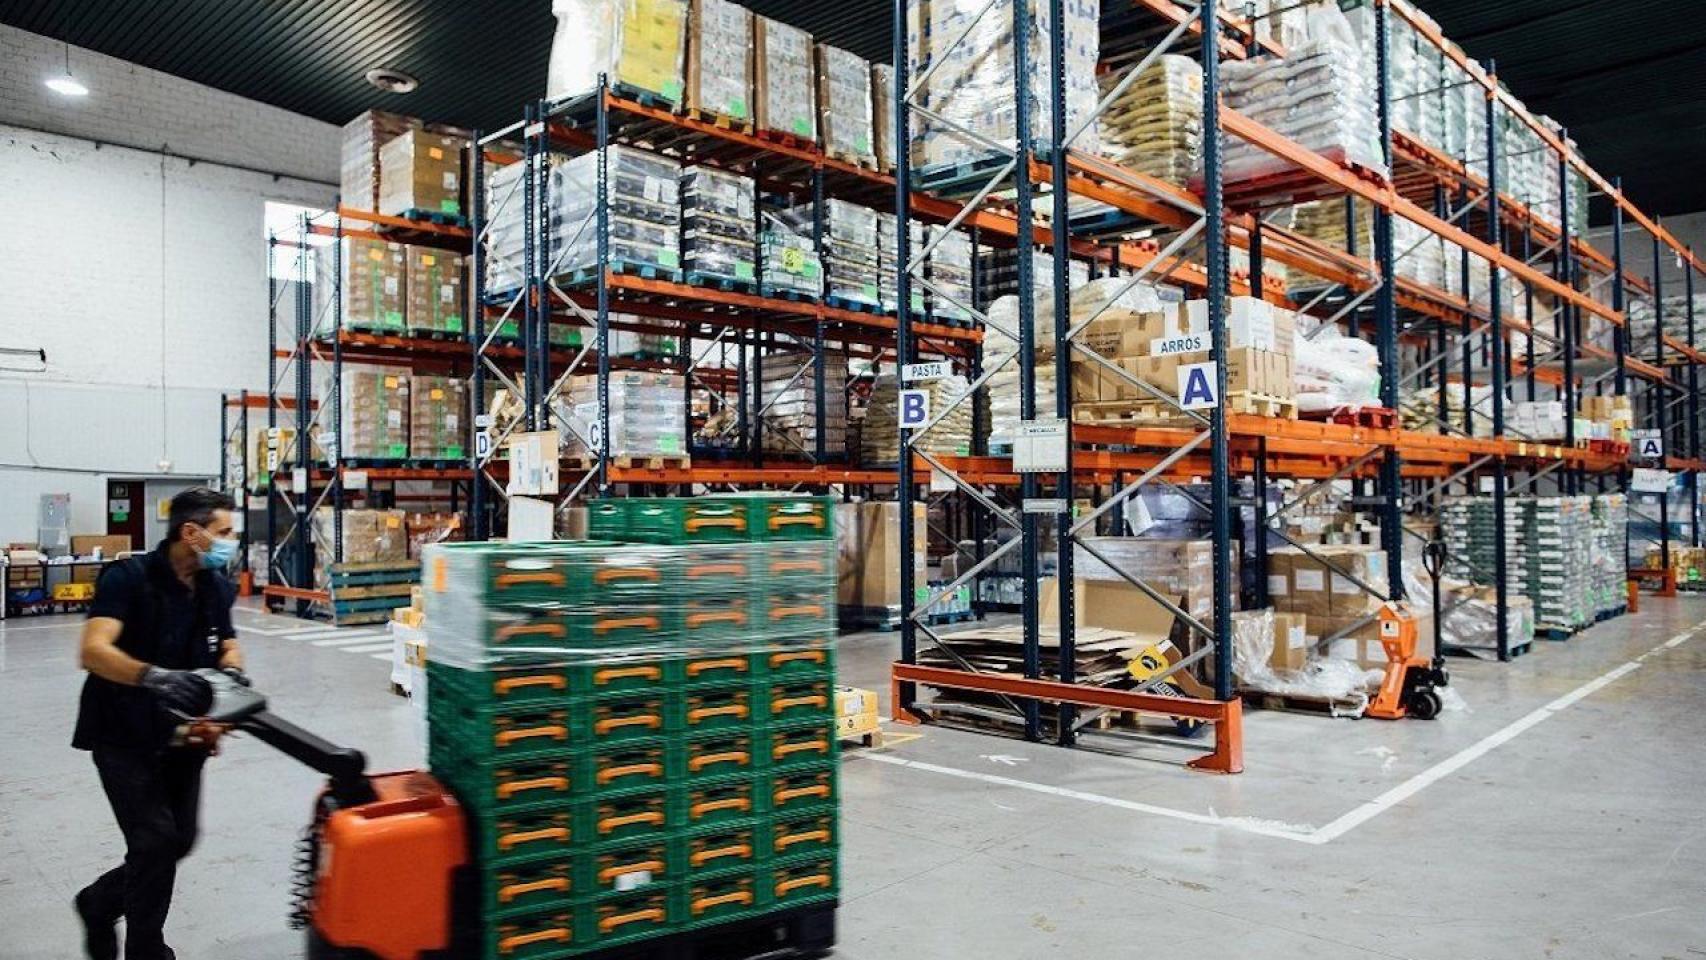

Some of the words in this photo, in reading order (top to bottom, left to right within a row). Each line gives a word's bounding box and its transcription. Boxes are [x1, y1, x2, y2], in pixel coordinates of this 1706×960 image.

[912, 364, 942, 377] PASTA
[1183, 368, 1214, 405] A
[903, 394, 926, 424] B
[479, 435, 487, 454] D
[590, 423, 599, 446] C
[1643, 440, 1659, 454] A
